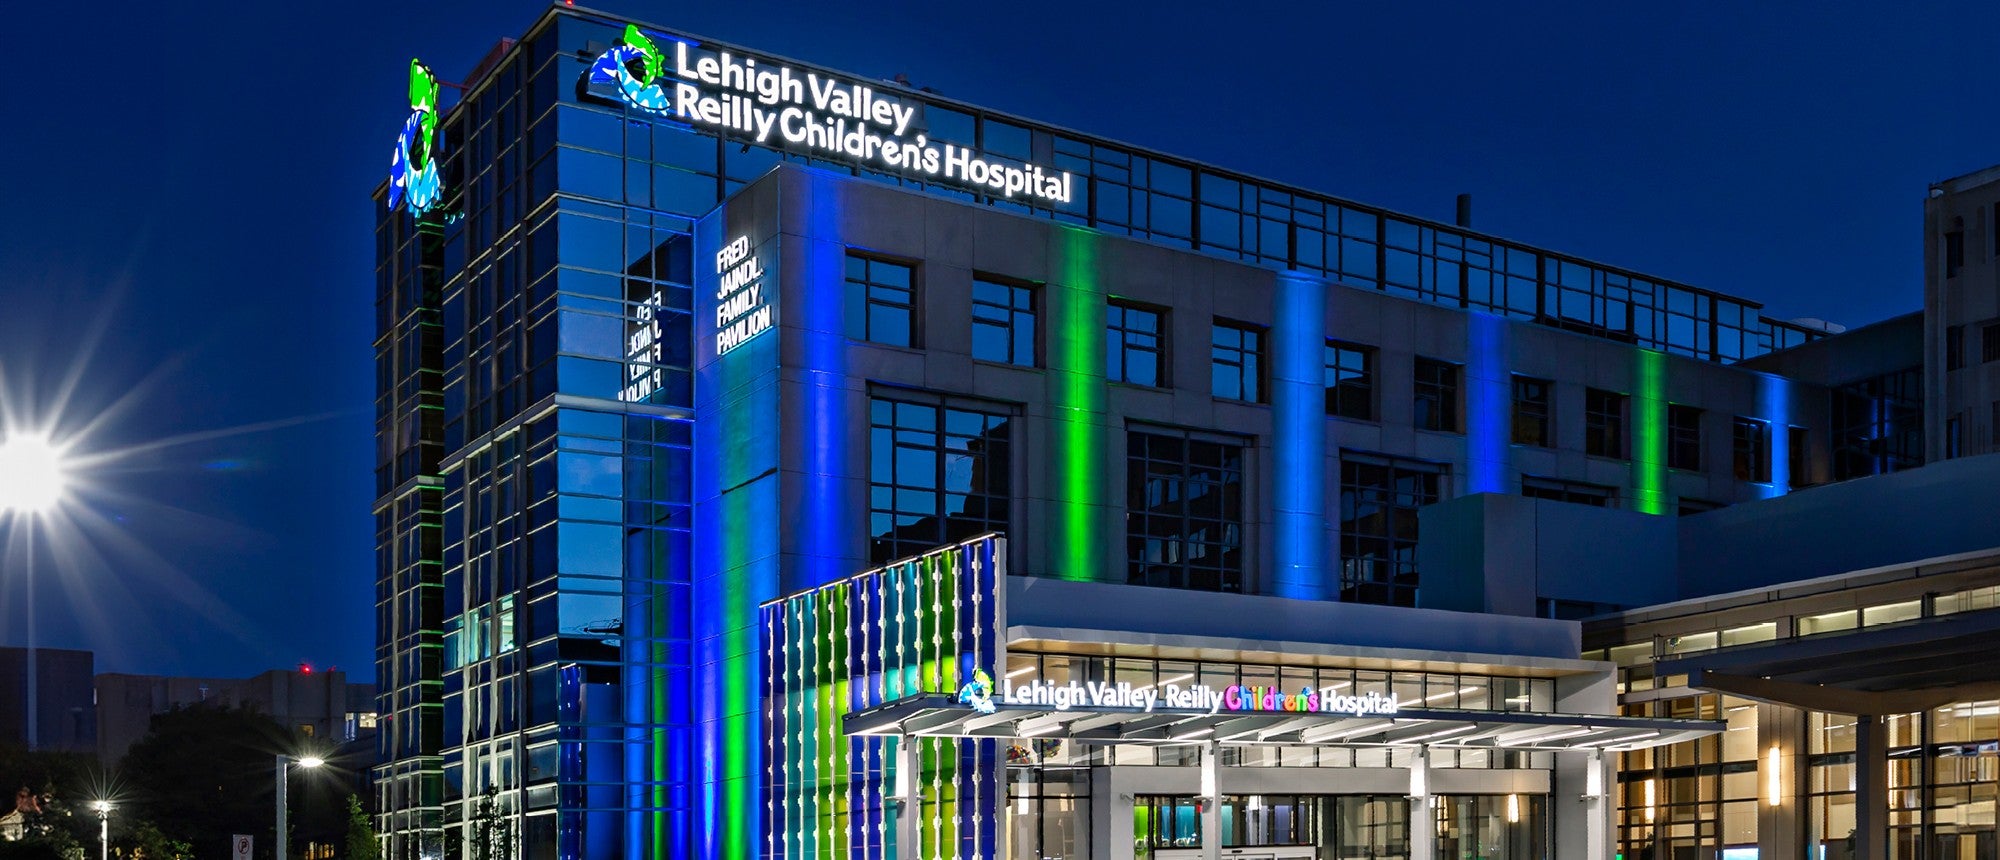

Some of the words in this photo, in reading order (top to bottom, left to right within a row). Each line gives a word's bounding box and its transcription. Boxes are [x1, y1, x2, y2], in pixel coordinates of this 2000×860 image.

[676, 41, 803, 105] Lehigh
[807, 73, 914, 136] Valley
[676, 83, 776, 142] Reilly
[780, 107, 939, 174] Children's
[945, 144, 1071, 203] Hospital
[716, 235, 749, 274] FRED
[716, 256, 761, 300] JAINDL
[716, 283, 760, 328] FAMILY
[716, 305, 771, 356] PAVILION
[1003, 679, 1085, 711] Lehigh
[1087, 681, 1159, 713] Valley
[1165, 684, 1224, 717] Reilly
[1224, 684, 1319, 713] Children's
[1320, 689, 1398, 717] Hospital
